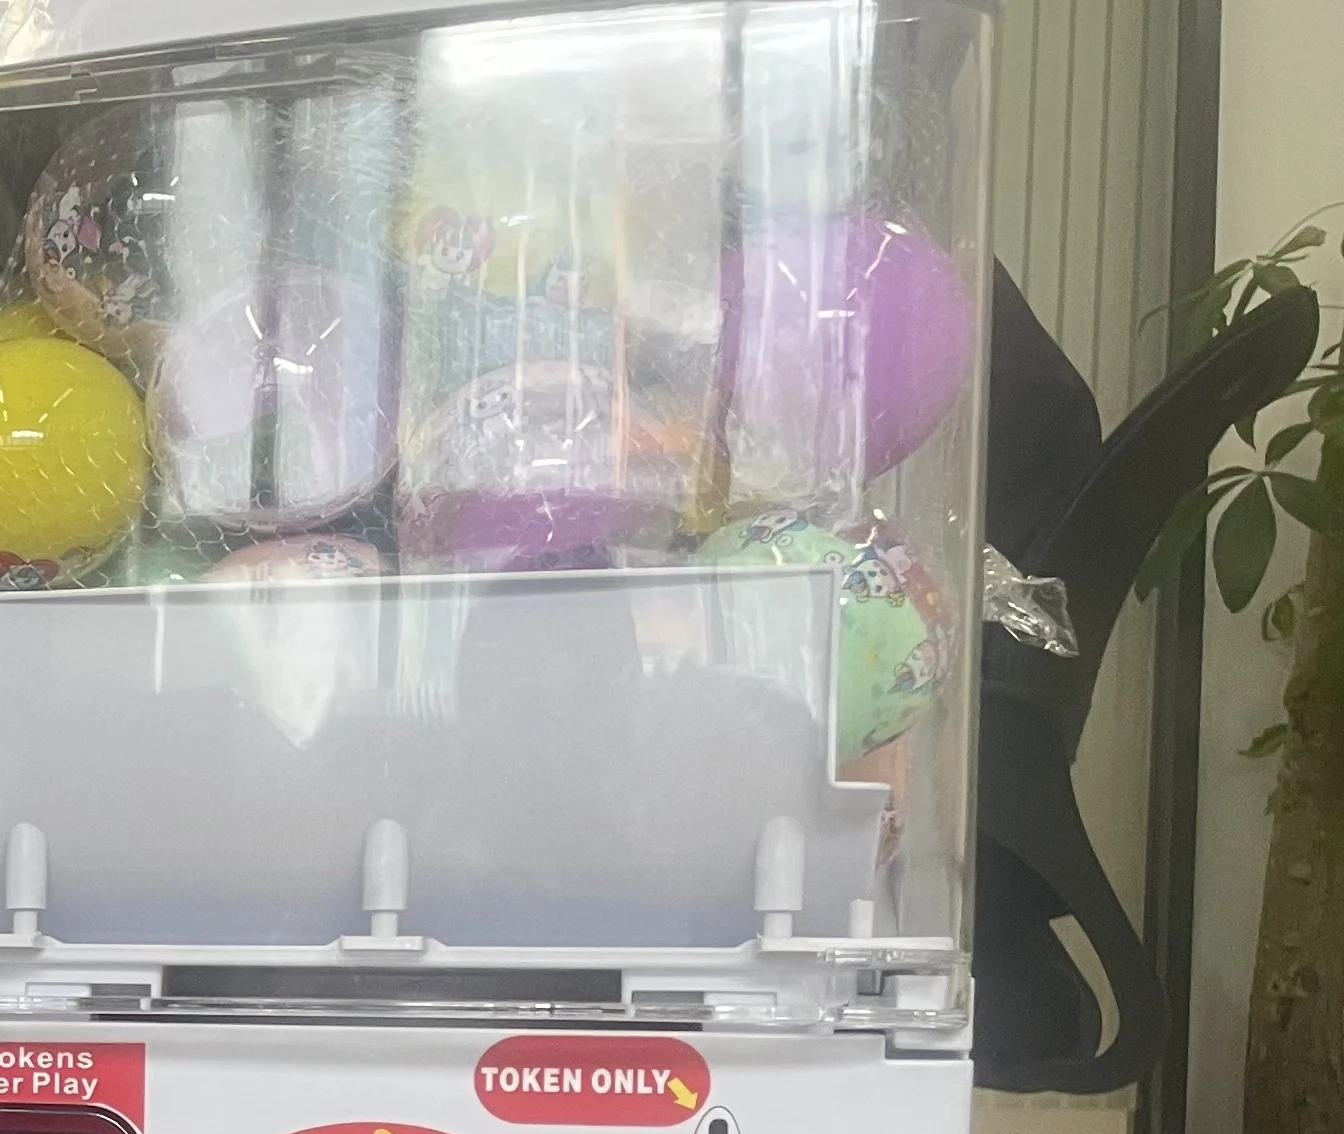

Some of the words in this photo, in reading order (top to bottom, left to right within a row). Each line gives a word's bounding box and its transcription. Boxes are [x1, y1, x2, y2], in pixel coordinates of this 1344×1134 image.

[32, 1071, 98, 1101] Play
[481, 1066, 582, 1093] TOKEN
[591, 1068, 671, 1095] ONLY
